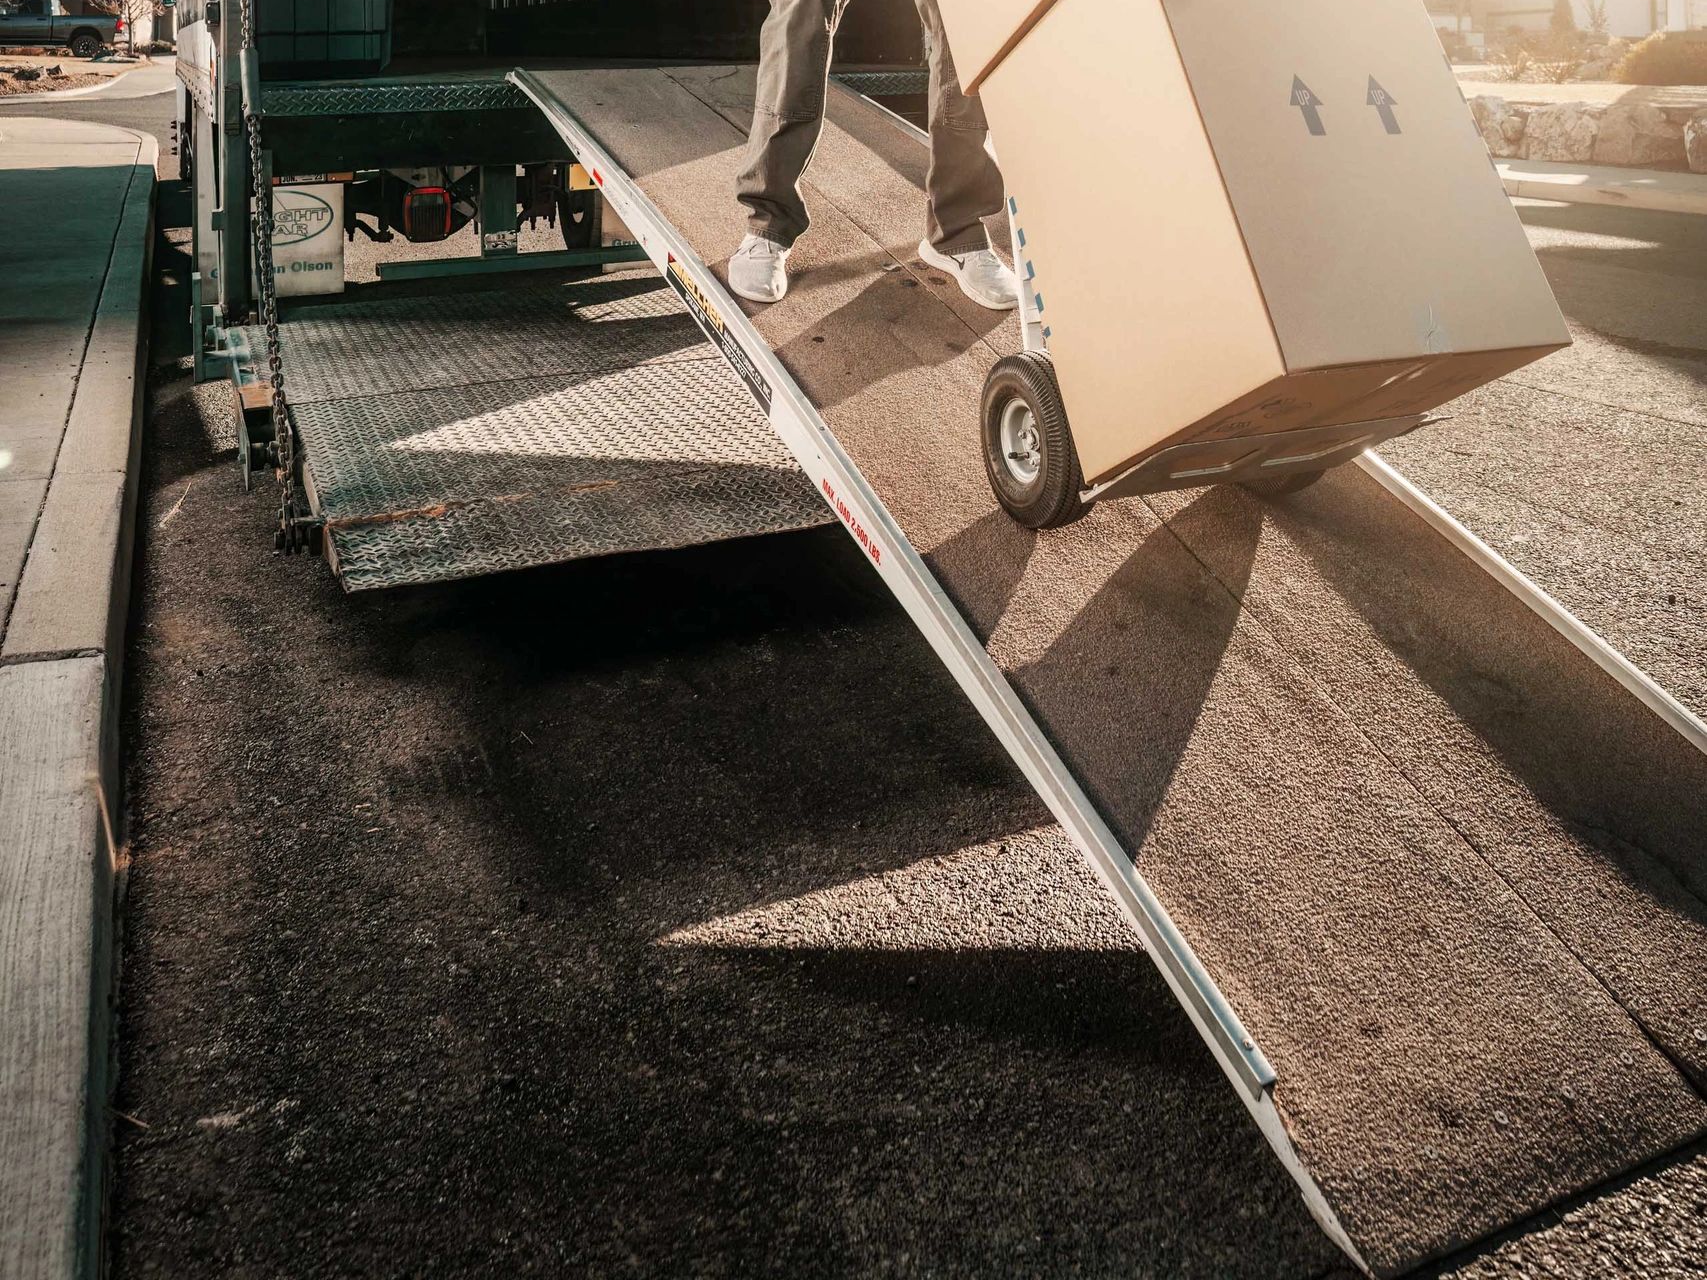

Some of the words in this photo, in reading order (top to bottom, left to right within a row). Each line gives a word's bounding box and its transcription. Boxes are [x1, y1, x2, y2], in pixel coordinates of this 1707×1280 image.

[1295, 89, 1310, 106] UP
[1371, 89, 1385, 105] UP
[273, 208, 329, 222] GHT
[290, 261, 334, 273] Olson
[822, 478, 836, 504] MAX.
[836, 496, 851, 524] LOAD
[868, 539, 882, 567] LBS.
